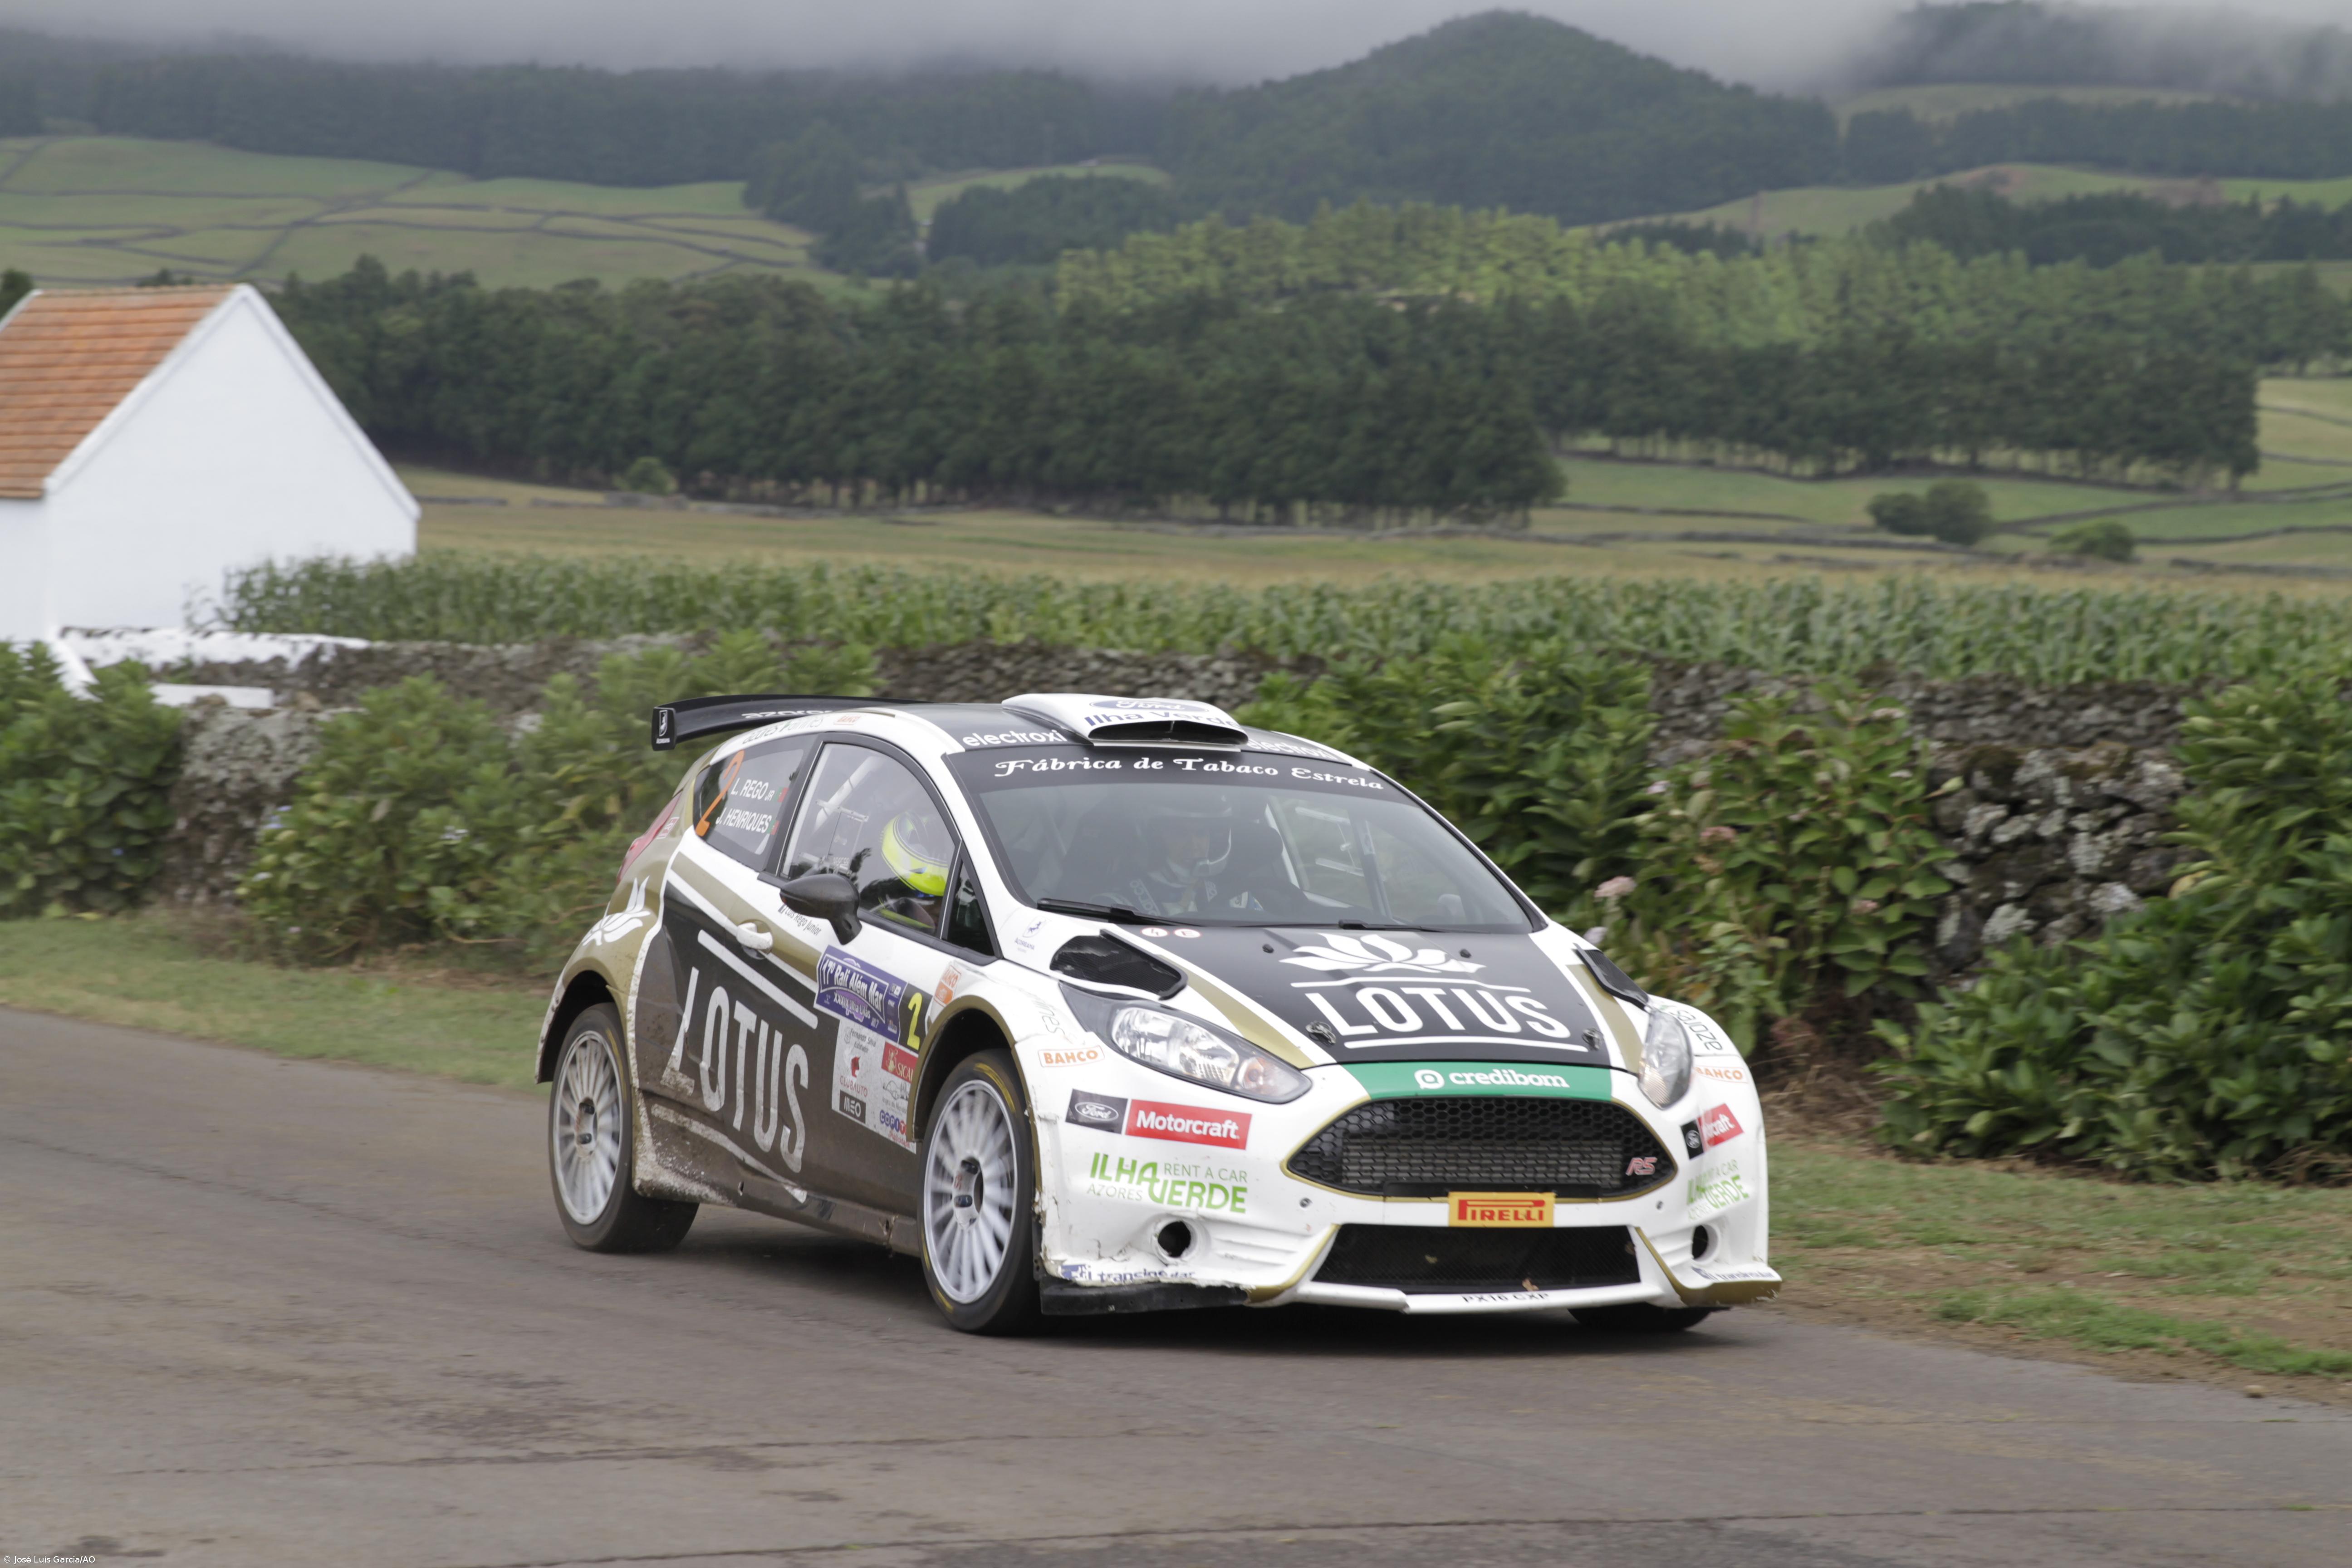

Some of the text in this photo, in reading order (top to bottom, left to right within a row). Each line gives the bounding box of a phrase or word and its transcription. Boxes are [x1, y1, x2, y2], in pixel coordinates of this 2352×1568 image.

[1112, 699, 1185, 710] Ford
[1084, 711, 1242, 727] Ilha Verde
[995, 757, 1384, 789] Fábrica de Tabaco Estrela
[695, 749, 745, 837] 2
[731, 777, 775, 801] L. REGO JR
[715, 807, 773, 833] J. HENRIQUES
[794, 913, 808, 927] Rego
[833, 964, 851, 988] Rali
[848, 972, 868, 999] Além
[868, 981, 883, 1013] Mar
[833, 992, 850, 1010] XXXIX
[907, 992, 922, 1049] 2
[1305, 987, 1572, 1039] LOTUS
[1044, 1050, 1098, 1064] BAHCO
[660, 966, 809, 1174] LOTUS
[1449, 1068, 1570, 1088] credibom
[839, 1075, 868, 1098] CLUBAUTO
[843, 1095, 862, 1118] MEO
[1081, 1104, 1115, 1120] Ford
[880, 1109, 907, 1135] COPIT
[1136, 1110, 1239, 1139] Motorcraft
[1089, 1152, 1248, 1186] ILHA RENT A CAR
[1626, 1157, 1658, 1176] RS
[1087, 1183, 1143, 1201] AZORES
[1457, 1199, 1546, 1222] PIRELLI
